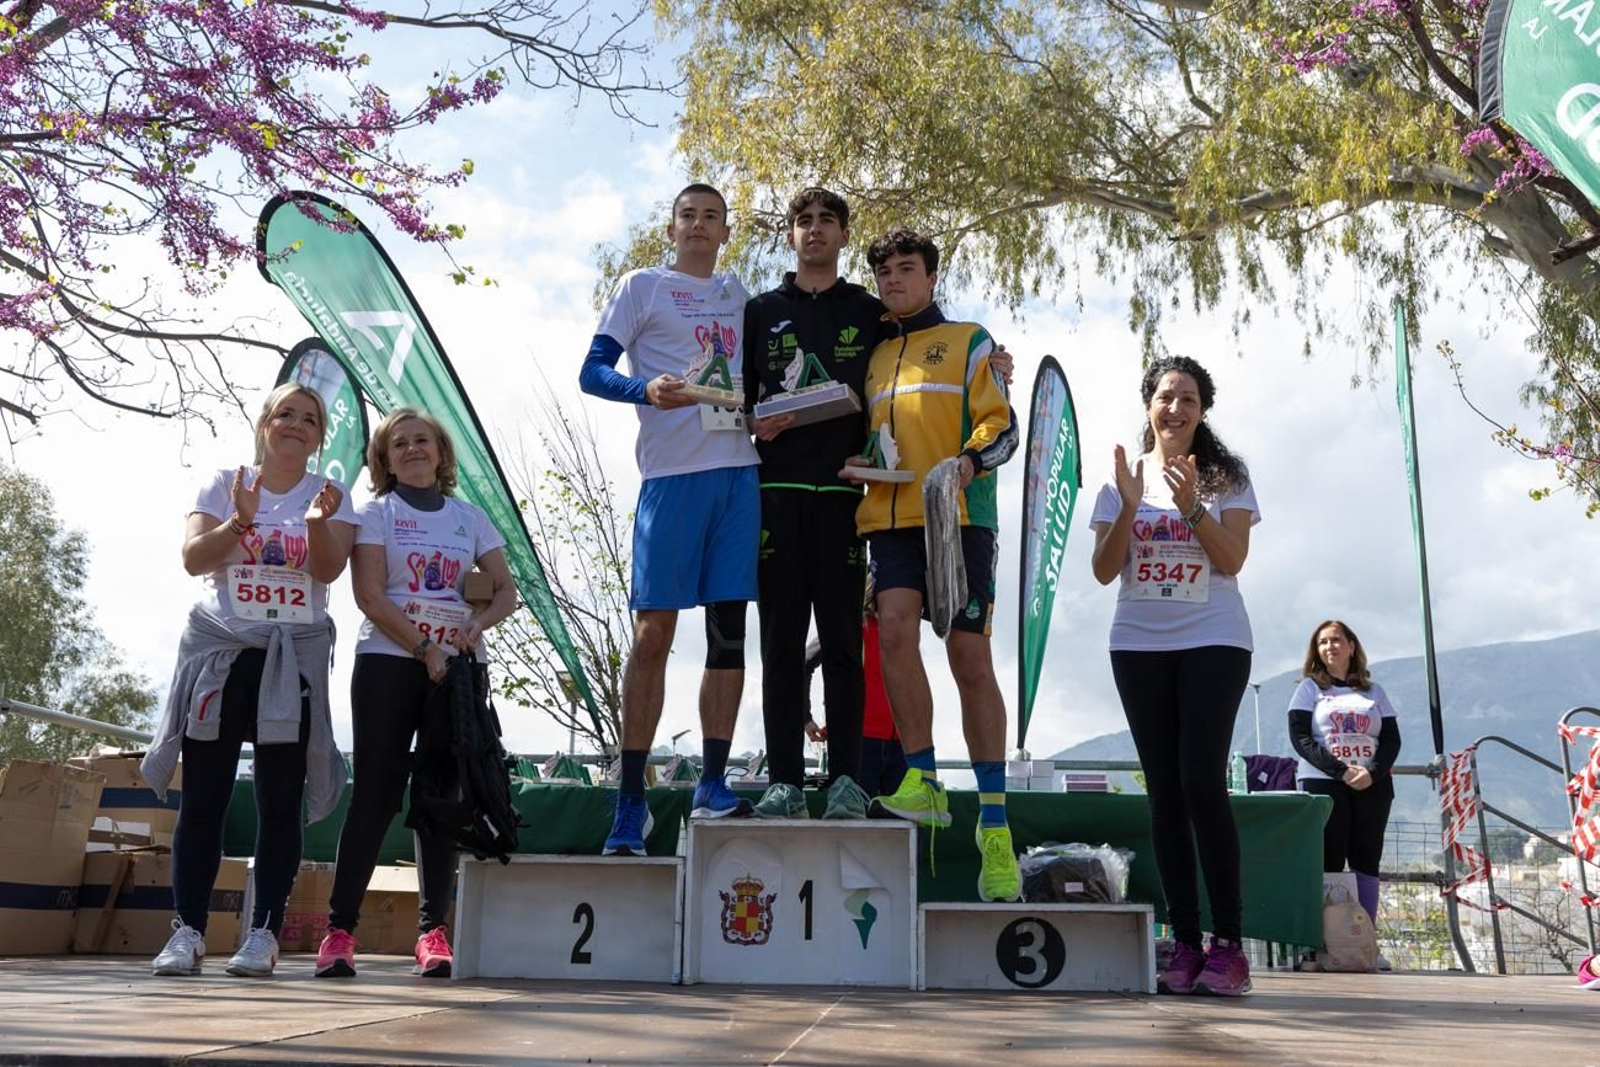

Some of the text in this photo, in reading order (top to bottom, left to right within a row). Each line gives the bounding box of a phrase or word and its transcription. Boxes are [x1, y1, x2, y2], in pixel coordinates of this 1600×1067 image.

[1137, 562, 1203, 584] 5347
[237, 583, 306, 607] 5812
[409, 618, 458, 646] 813
[1332, 746, 1373, 758] 5815
[798, 879, 812, 941] 1
[570, 902, 595, 965] 2
[1015, 920, 1048, 985] 3
